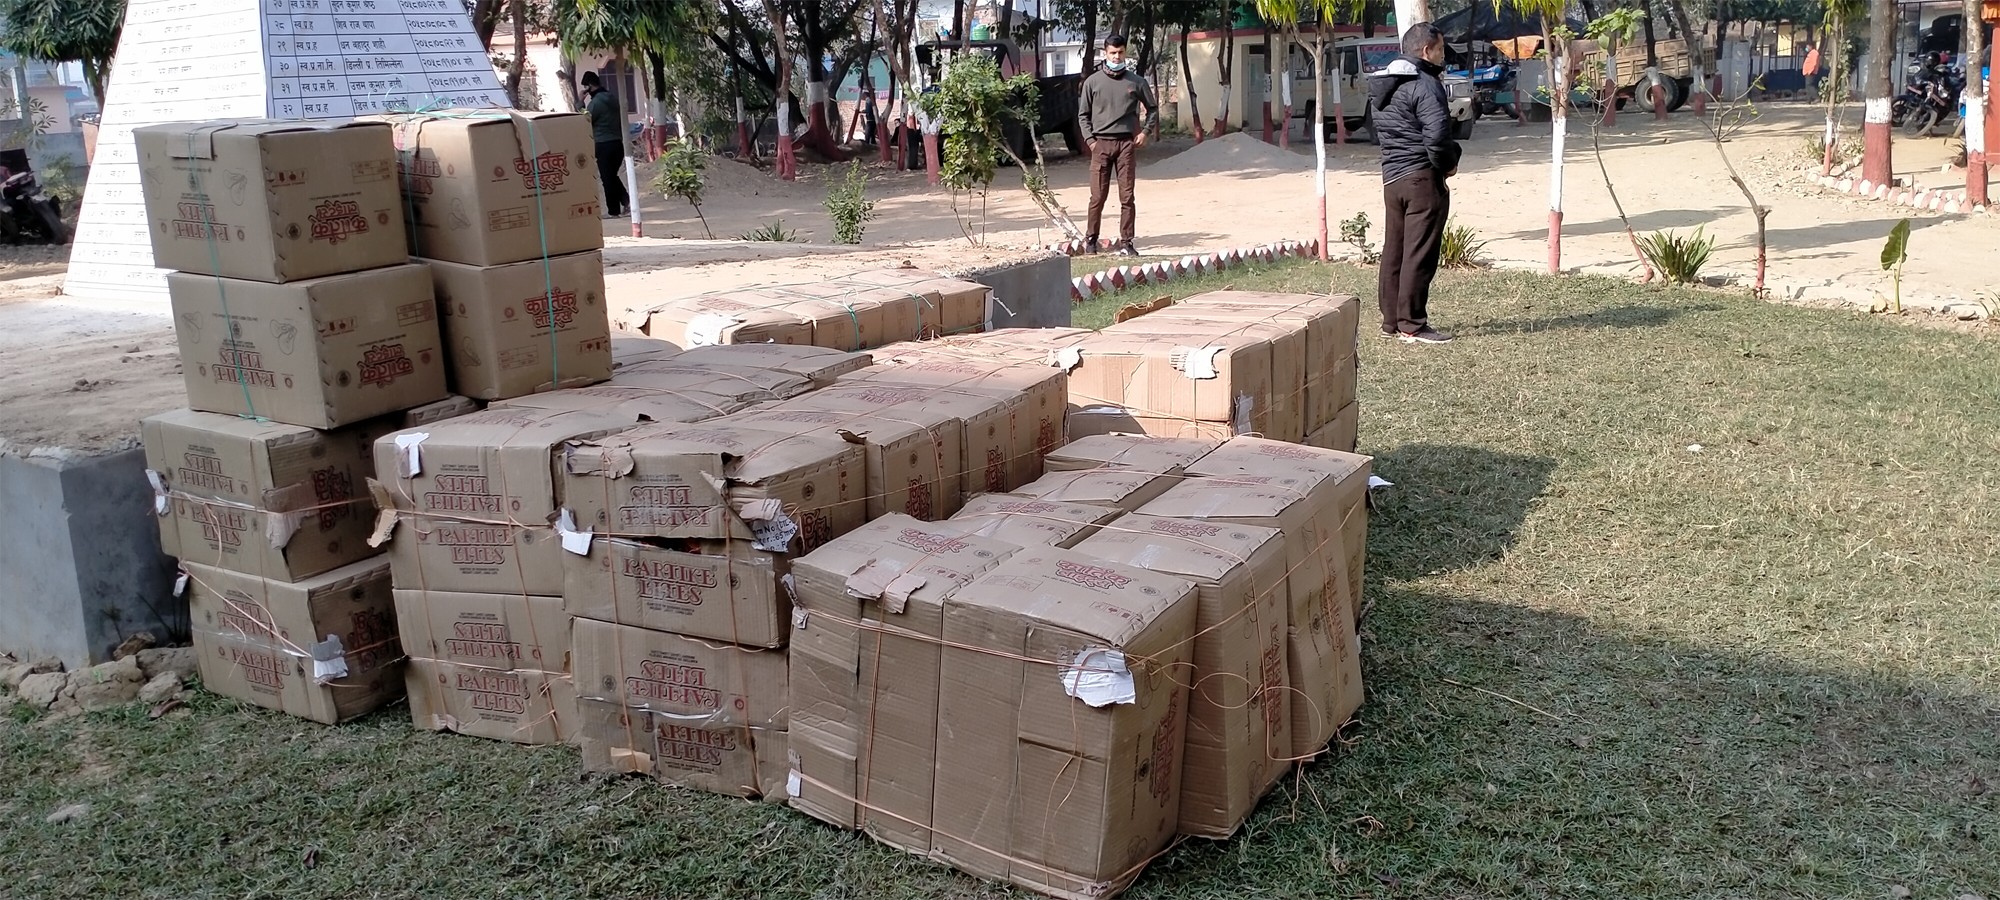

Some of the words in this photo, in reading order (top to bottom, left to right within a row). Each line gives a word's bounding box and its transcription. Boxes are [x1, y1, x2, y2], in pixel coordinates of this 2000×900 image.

[274, 20, 285, 30] २८
[349, 20, 360, 29] राज
[277, 41, 287, 52] २९
[280, 61, 290, 72] ३०
[281, 83, 291, 94] ३१
[283, 104, 294, 115] ३२
[435, 474, 489, 495] LITES
[630, 485, 692, 506] LITES
[452, 545, 506, 565] LITES
[623, 558, 718, 590] KARTIKE
[640, 578, 704, 607] LITES
[453, 621, 507, 641] LITES
[639, 659, 707, 687] LITES
[472, 692, 526, 715] LITES
